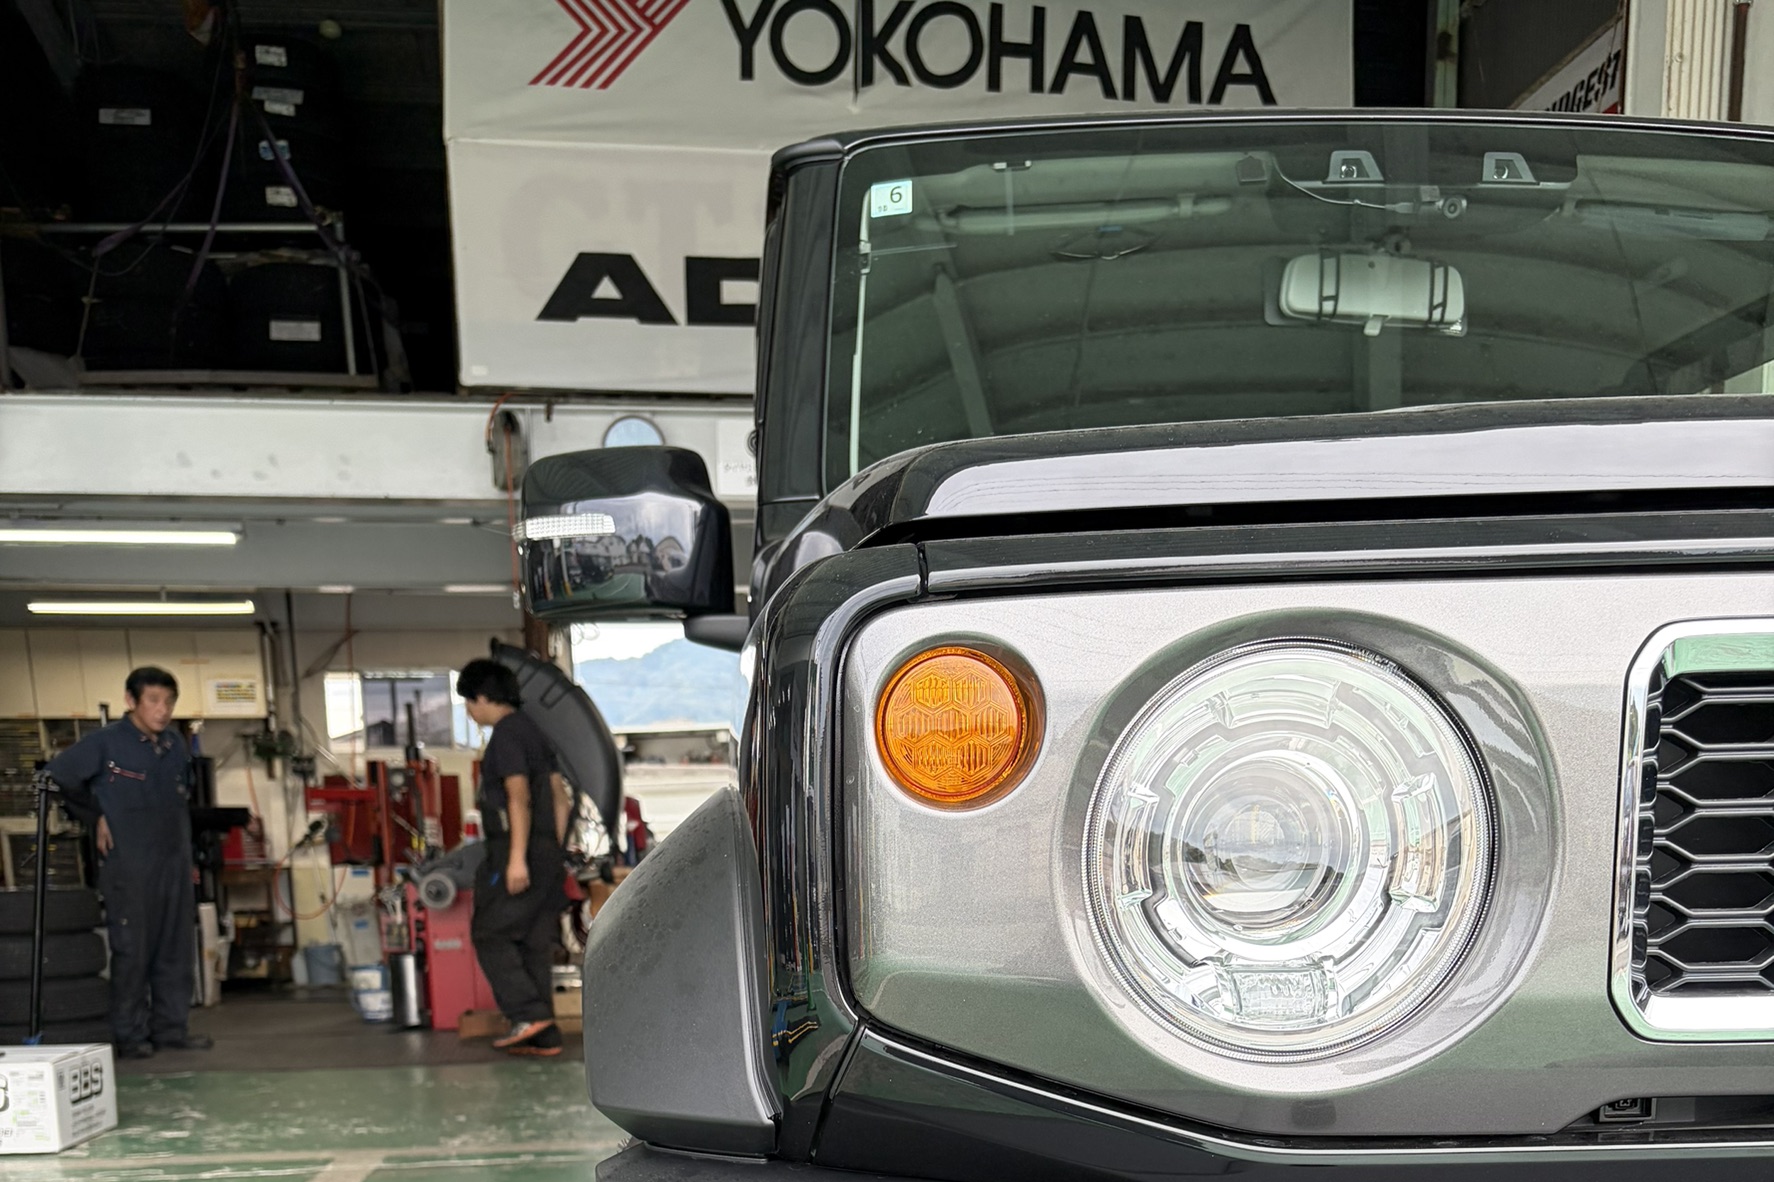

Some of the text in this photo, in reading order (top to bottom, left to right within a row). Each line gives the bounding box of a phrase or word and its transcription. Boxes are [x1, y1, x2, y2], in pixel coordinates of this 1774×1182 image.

[722, 0, 1277, 105] YOKOHAMA
[890, 186, 902, 203] 6
[69, 1061, 103, 1104] BBS
